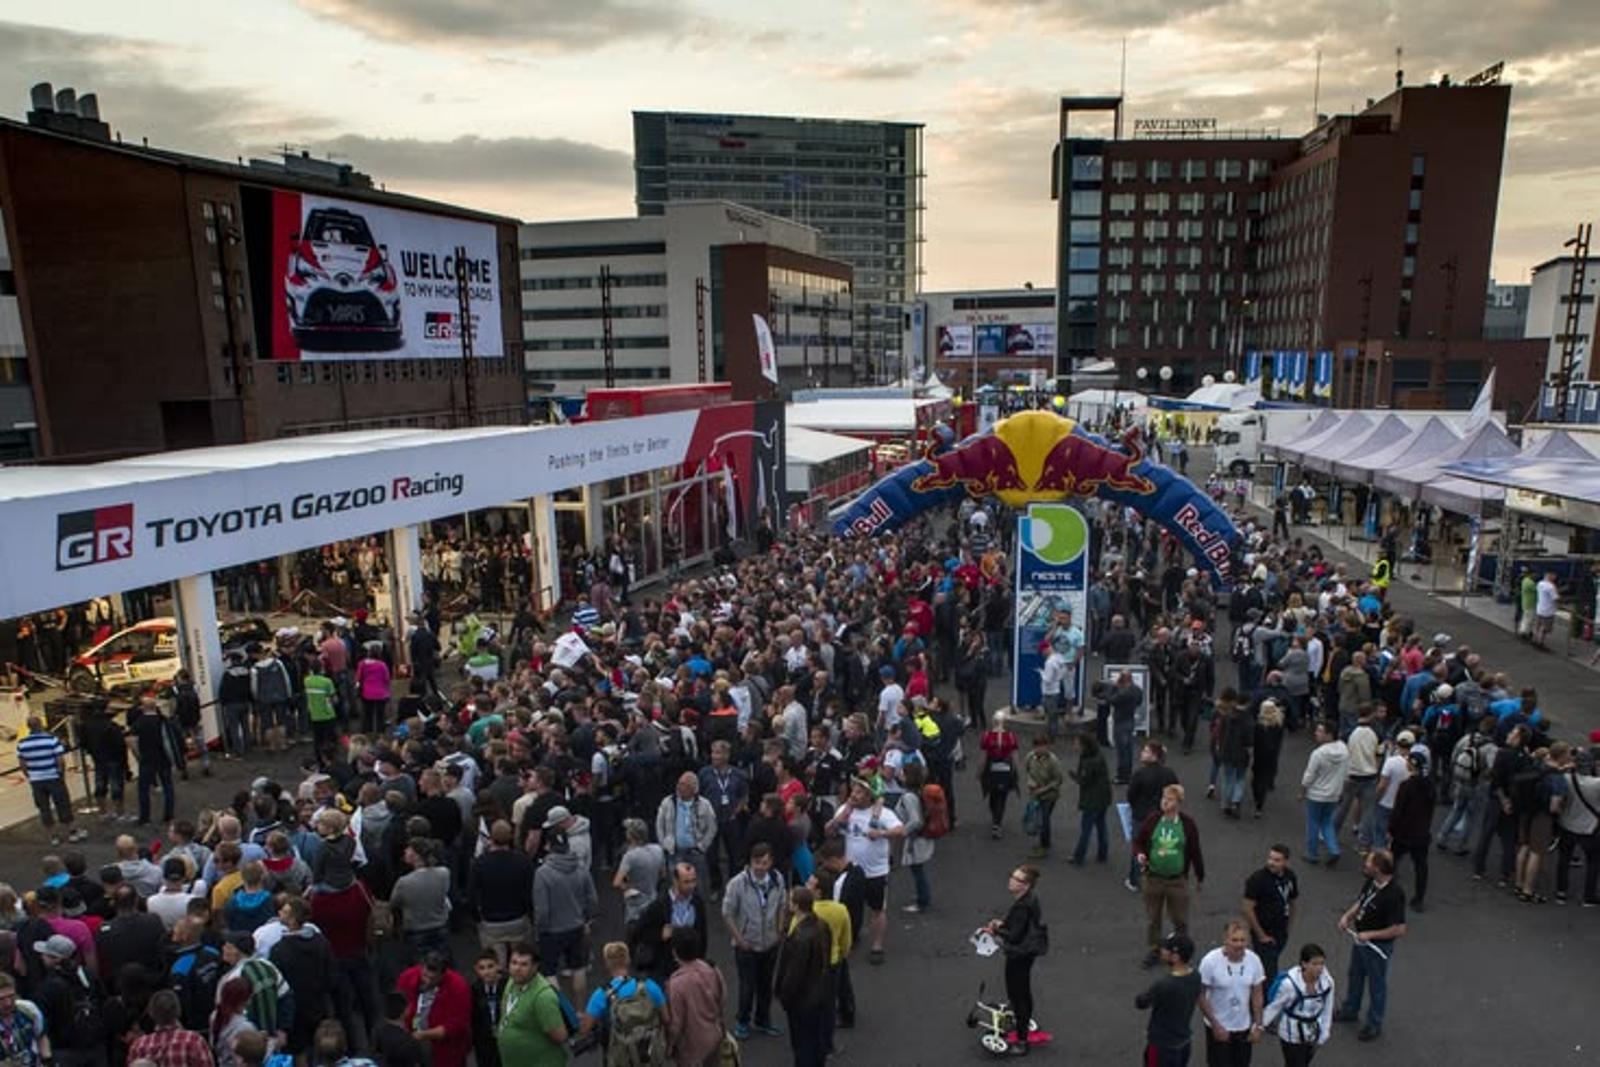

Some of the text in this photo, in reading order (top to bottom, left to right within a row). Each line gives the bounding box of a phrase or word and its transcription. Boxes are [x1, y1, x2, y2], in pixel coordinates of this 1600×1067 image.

[1134, 118, 1216, 130] PAVILJONKI
[404, 281, 416, 298] TO
[435, 285, 460, 301] HOM
[548, 454, 586, 469] Pushing
[146, 472, 464, 548] TOYOTA GAZOO Racing
[1173, 503, 1220, 550] Red
[59, 526, 131, 566] GR
[1031, 571, 1073, 581] NESTE
